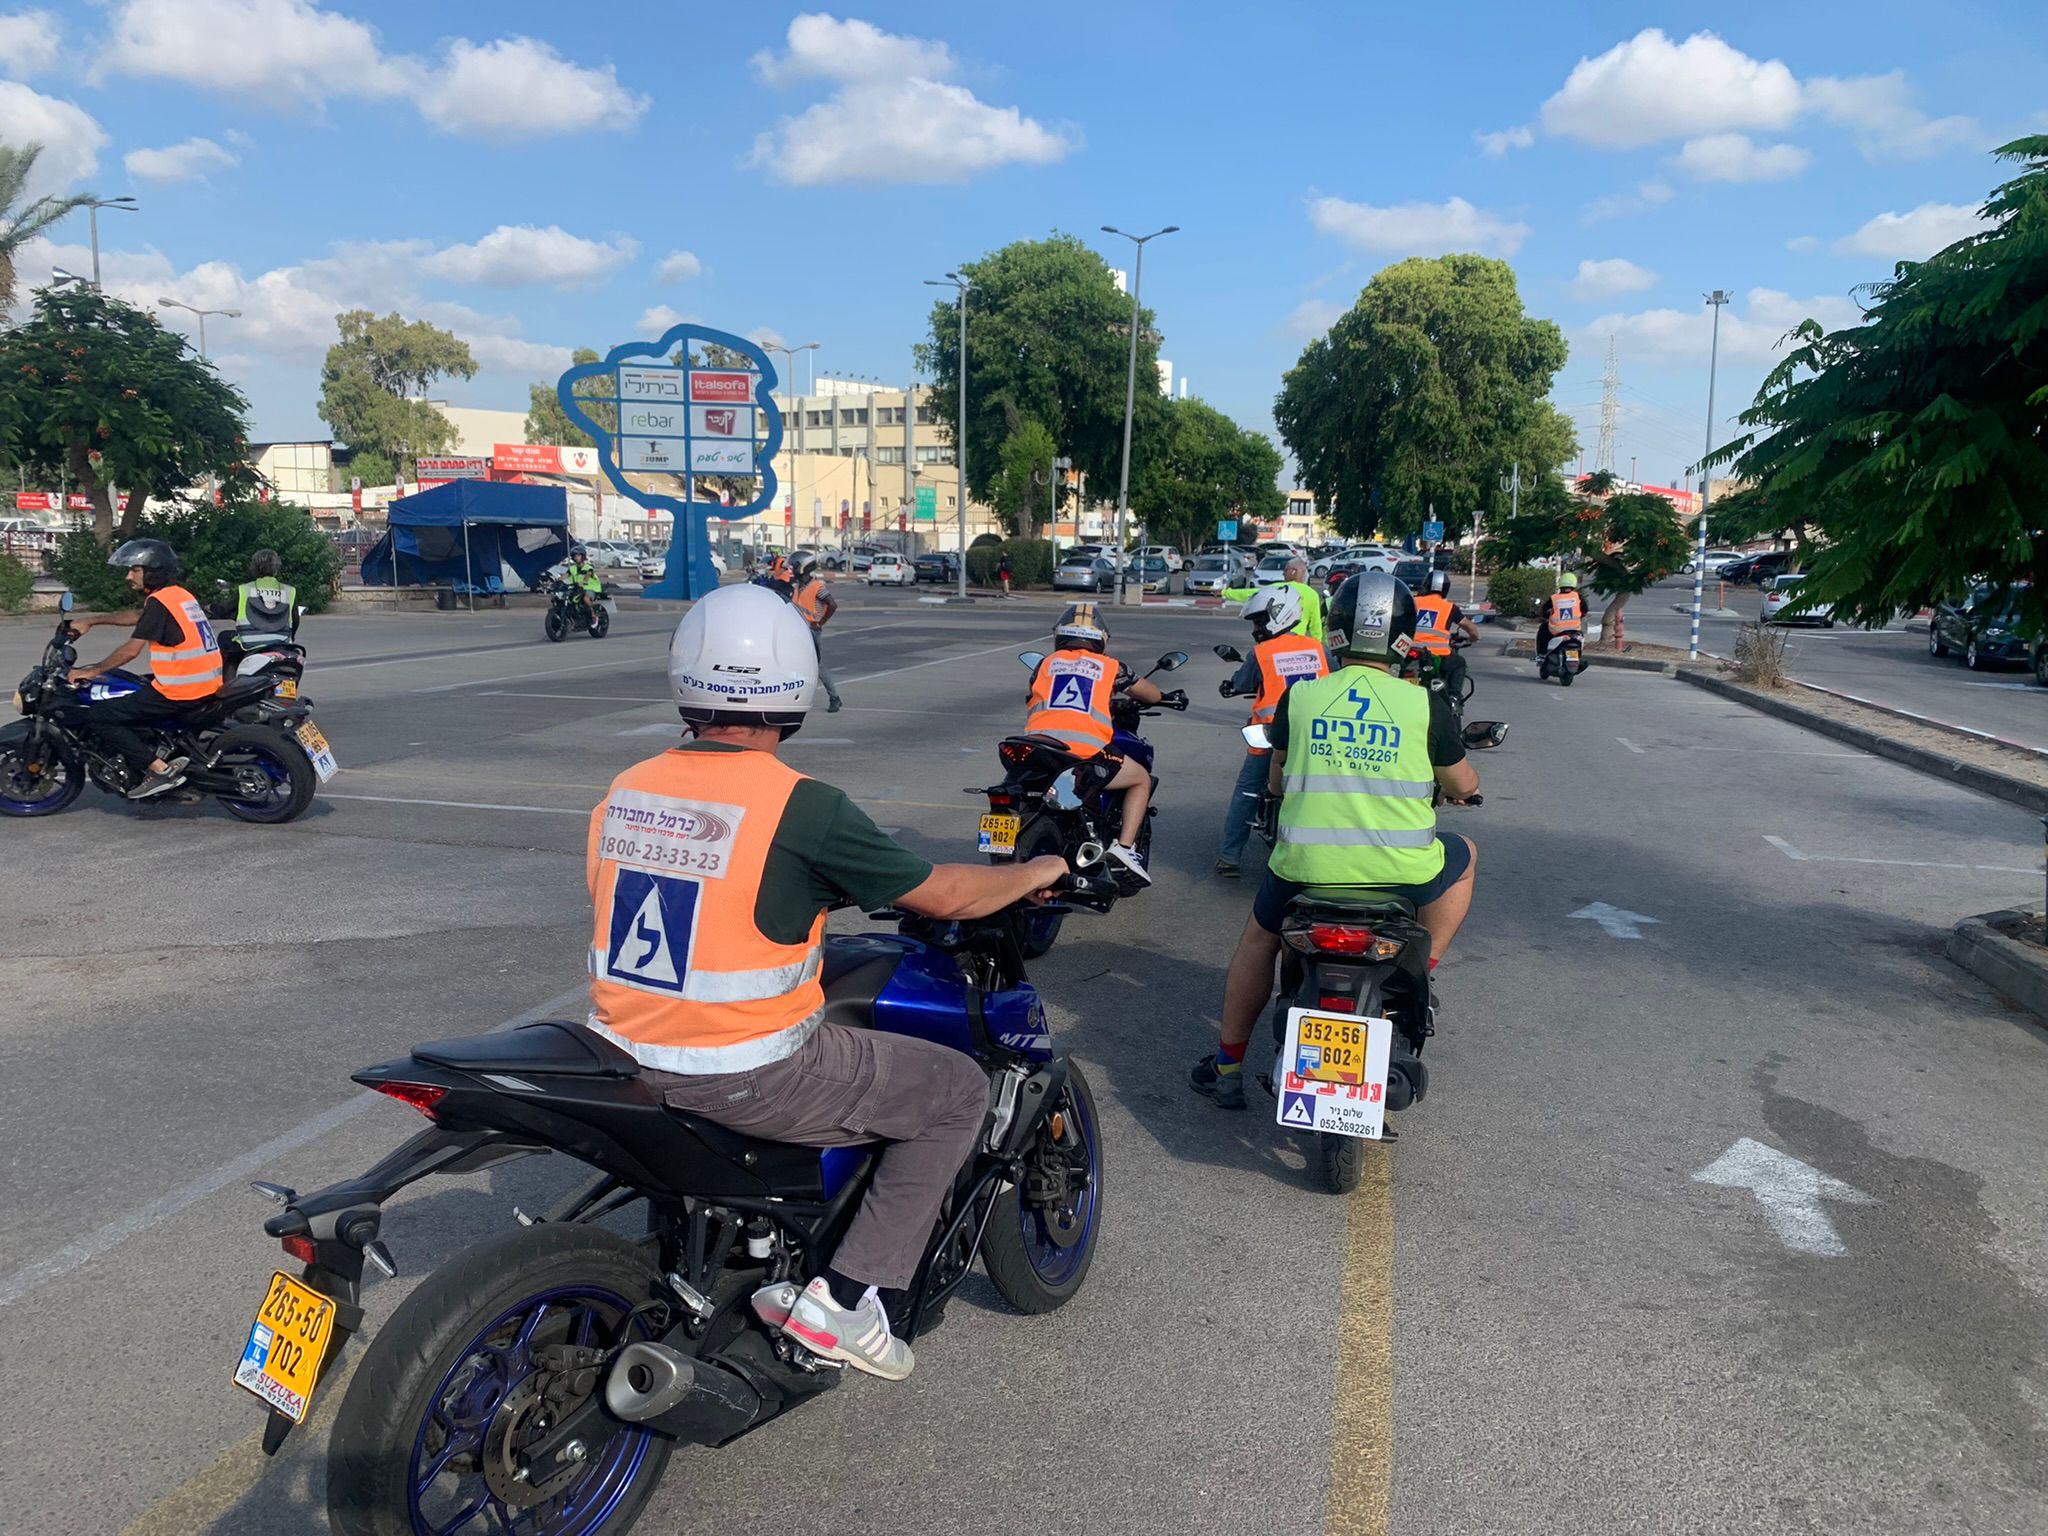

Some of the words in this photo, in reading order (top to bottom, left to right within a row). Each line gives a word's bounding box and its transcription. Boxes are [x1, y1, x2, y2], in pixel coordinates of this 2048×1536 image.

[624, 378, 680, 396] ביתילי
[694, 380, 746, 390] Italsofa
[631, 412, 675, 428] rebar
[712, 664, 762, 674] LS2
[707, 684, 736, 694] 2005
[738, 686, 780, 695] תחבורה
[782, 680, 806, 692] כרמל
[1065, 685, 1079, 704] ל
[1348, 688, 1371, 721] ל
[1311, 718, 1401, 748] נתיבים
[1324, 758, 1343, 768] ניר
[1349, 760, 1381, 772] שלום
[606, 804, 656, 826] תחבורה
[656, 810, 696, 832] כרמל
[992, 830, 1009, 842] 802
[600, 836, 721, 871] 1800-23-33-23
[634, 911, 661, 970] ל
[1001, 1032, 1036, 1048] MT
[1323, 1047, 1352, 1066] 602
[1294, 1104, 1304, 1118] ל
[1330, 1105, 1342, 1116] ניר
[1343, 1106, 1364, 1118] שלום
[1320, 1118, 1376, 1136] 052-2692261
[270, 1333, 304, 1379] 702
[257, 1372, 303, 1410] SUZUKA
